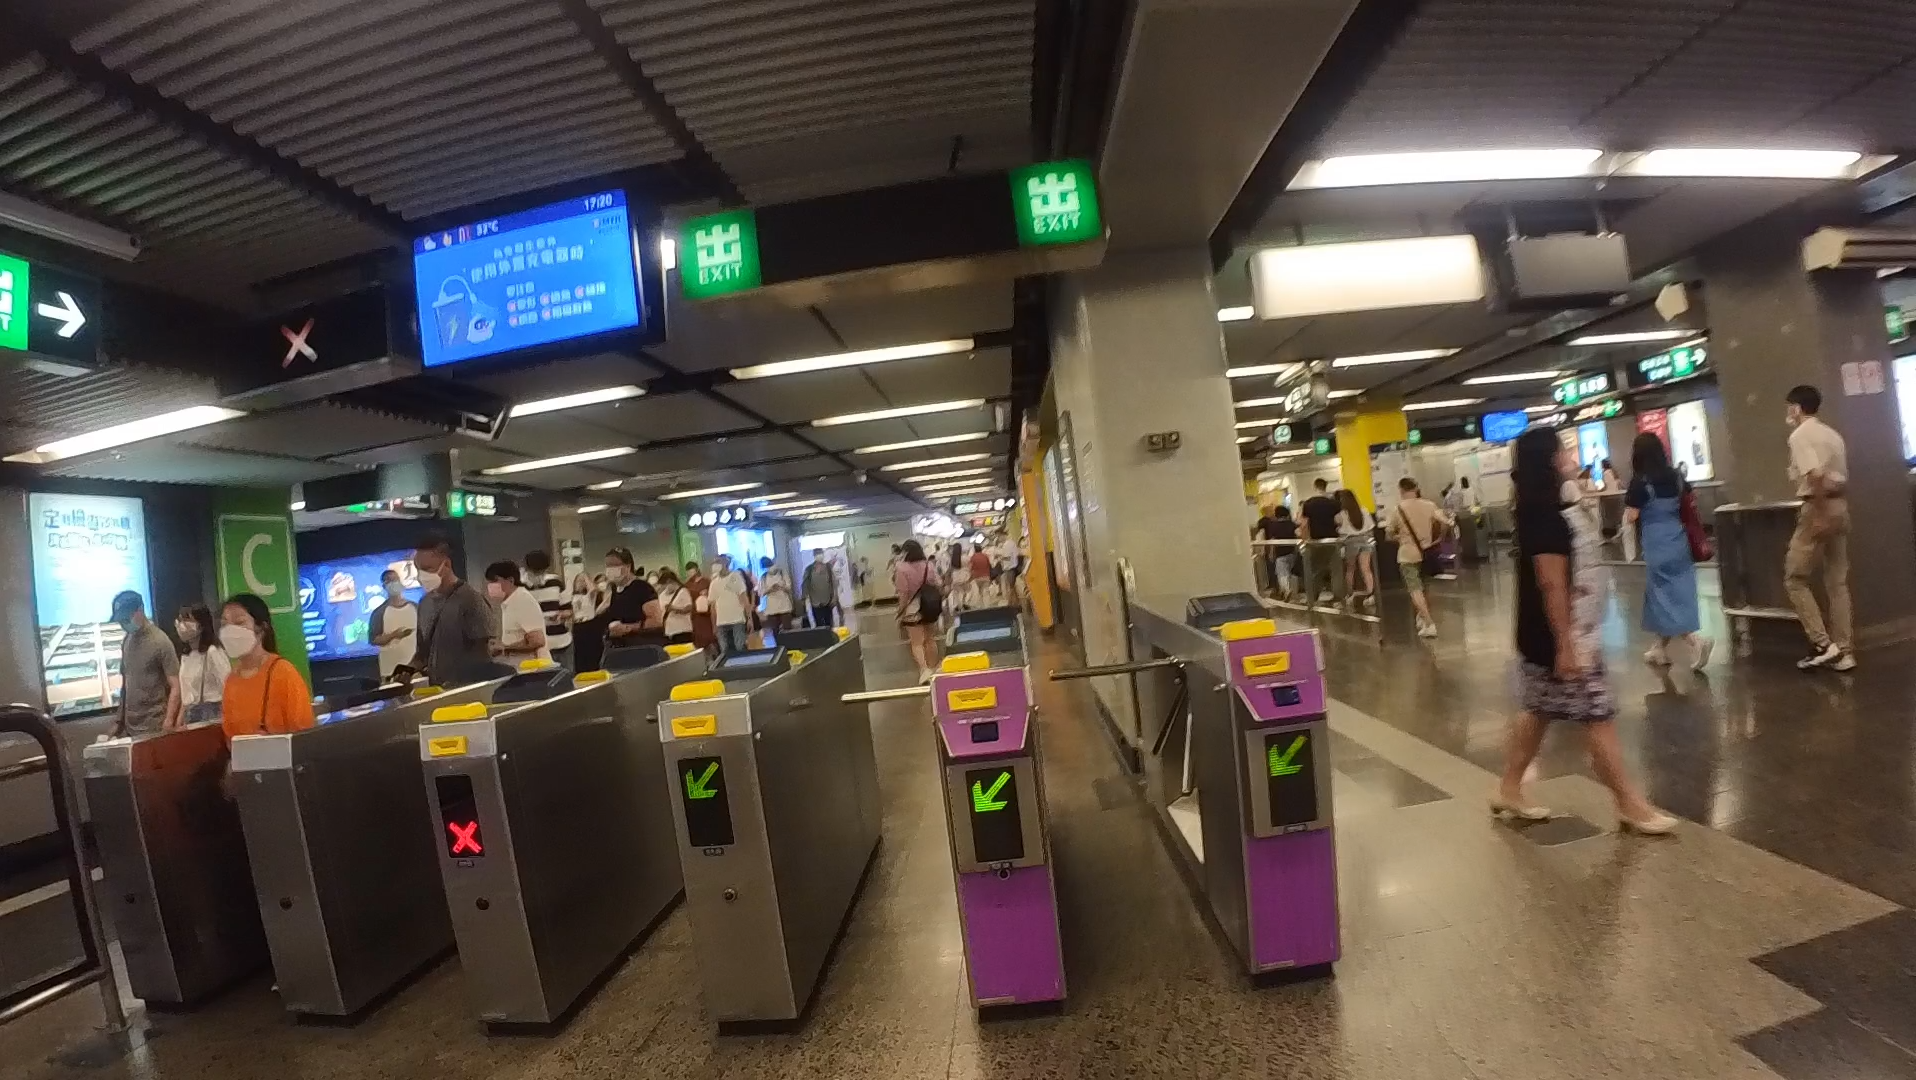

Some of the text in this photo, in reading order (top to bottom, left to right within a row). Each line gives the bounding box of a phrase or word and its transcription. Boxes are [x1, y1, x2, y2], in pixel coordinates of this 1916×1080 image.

[1027, 172, 1080, 219] 出
[1034, 211, 1081, 234] EXIT
[696, 223, 742, 268] 出
[699, 262, 743, 285] EXIT
[242, 534, 277, 595] C
